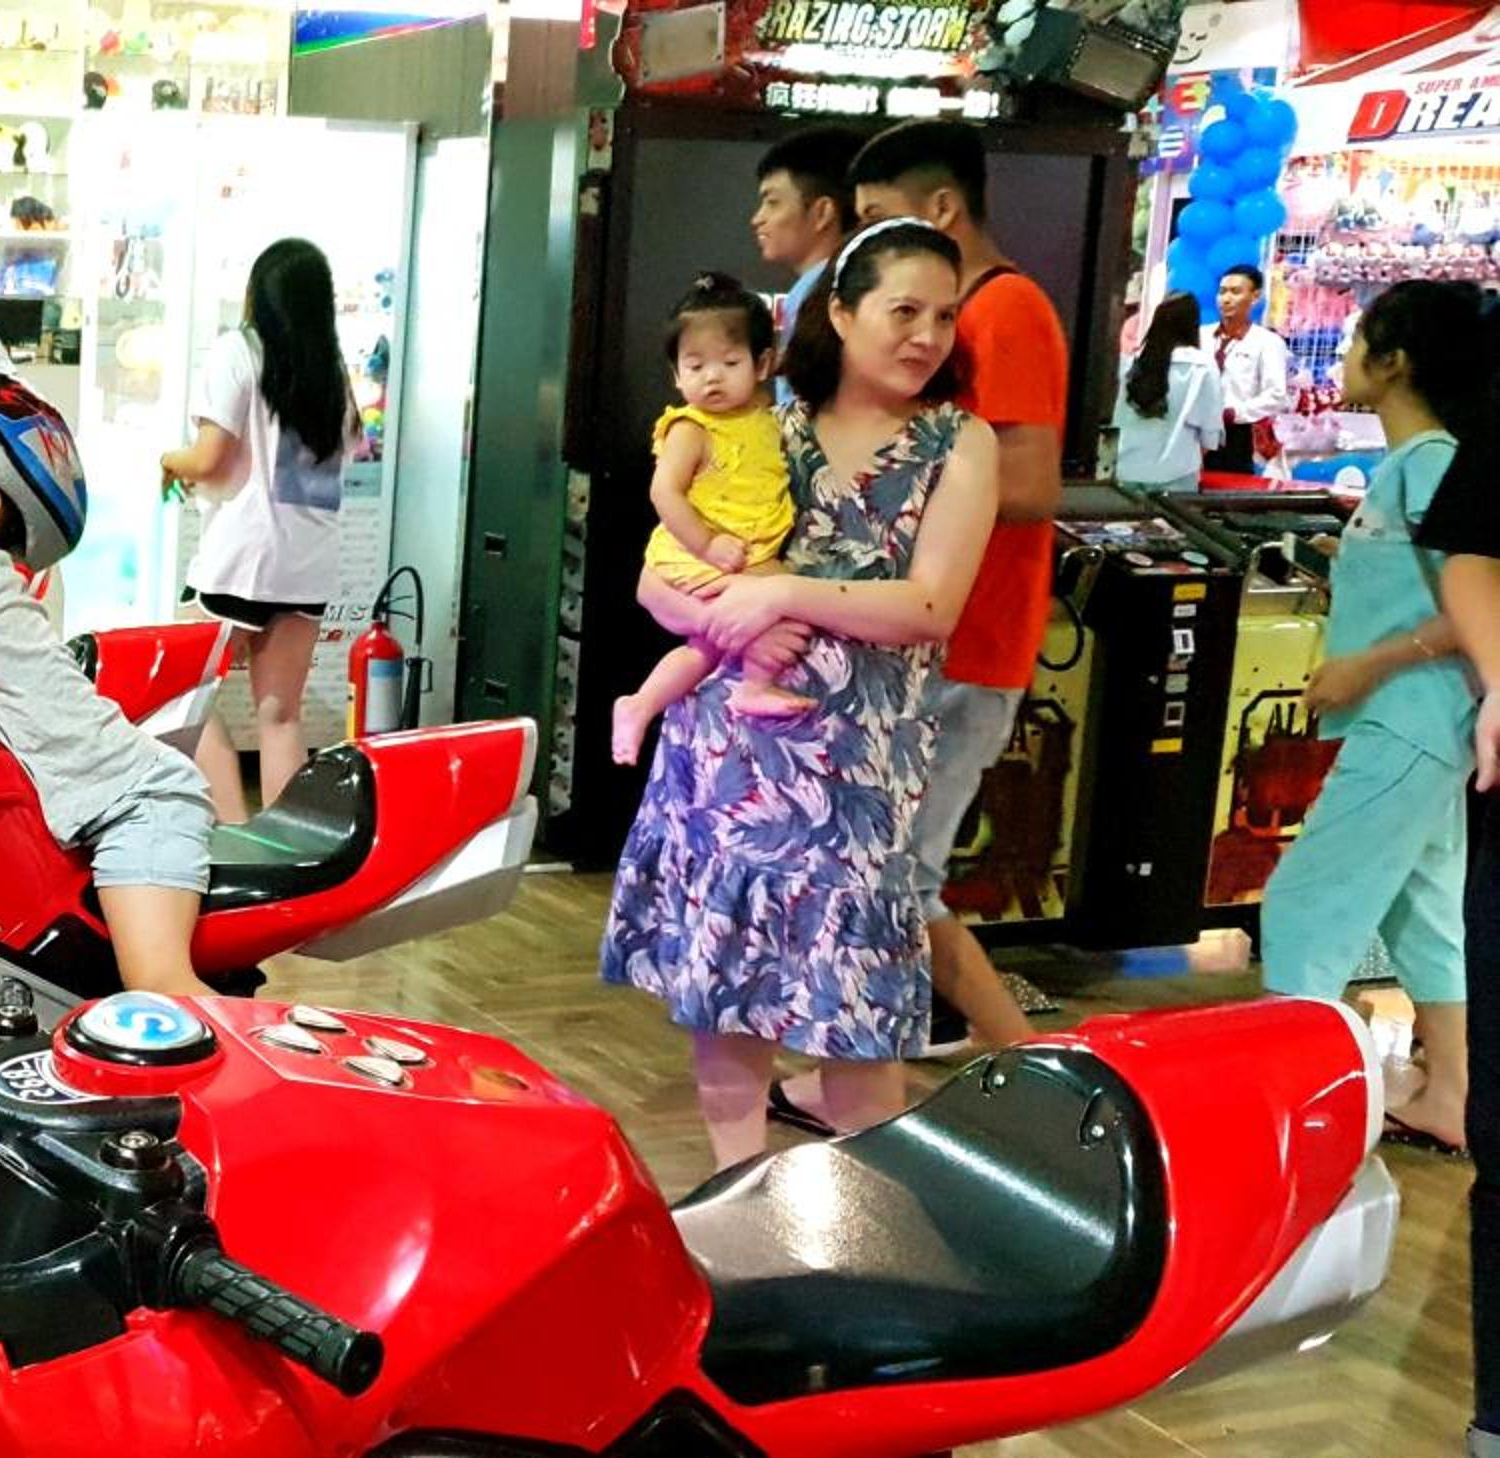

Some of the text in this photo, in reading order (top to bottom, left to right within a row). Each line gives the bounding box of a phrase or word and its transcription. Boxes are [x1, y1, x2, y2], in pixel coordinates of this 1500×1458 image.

[772, 1, 968, 49] RAZING STORM
[1415, 78, 1463, 95] SUPER
